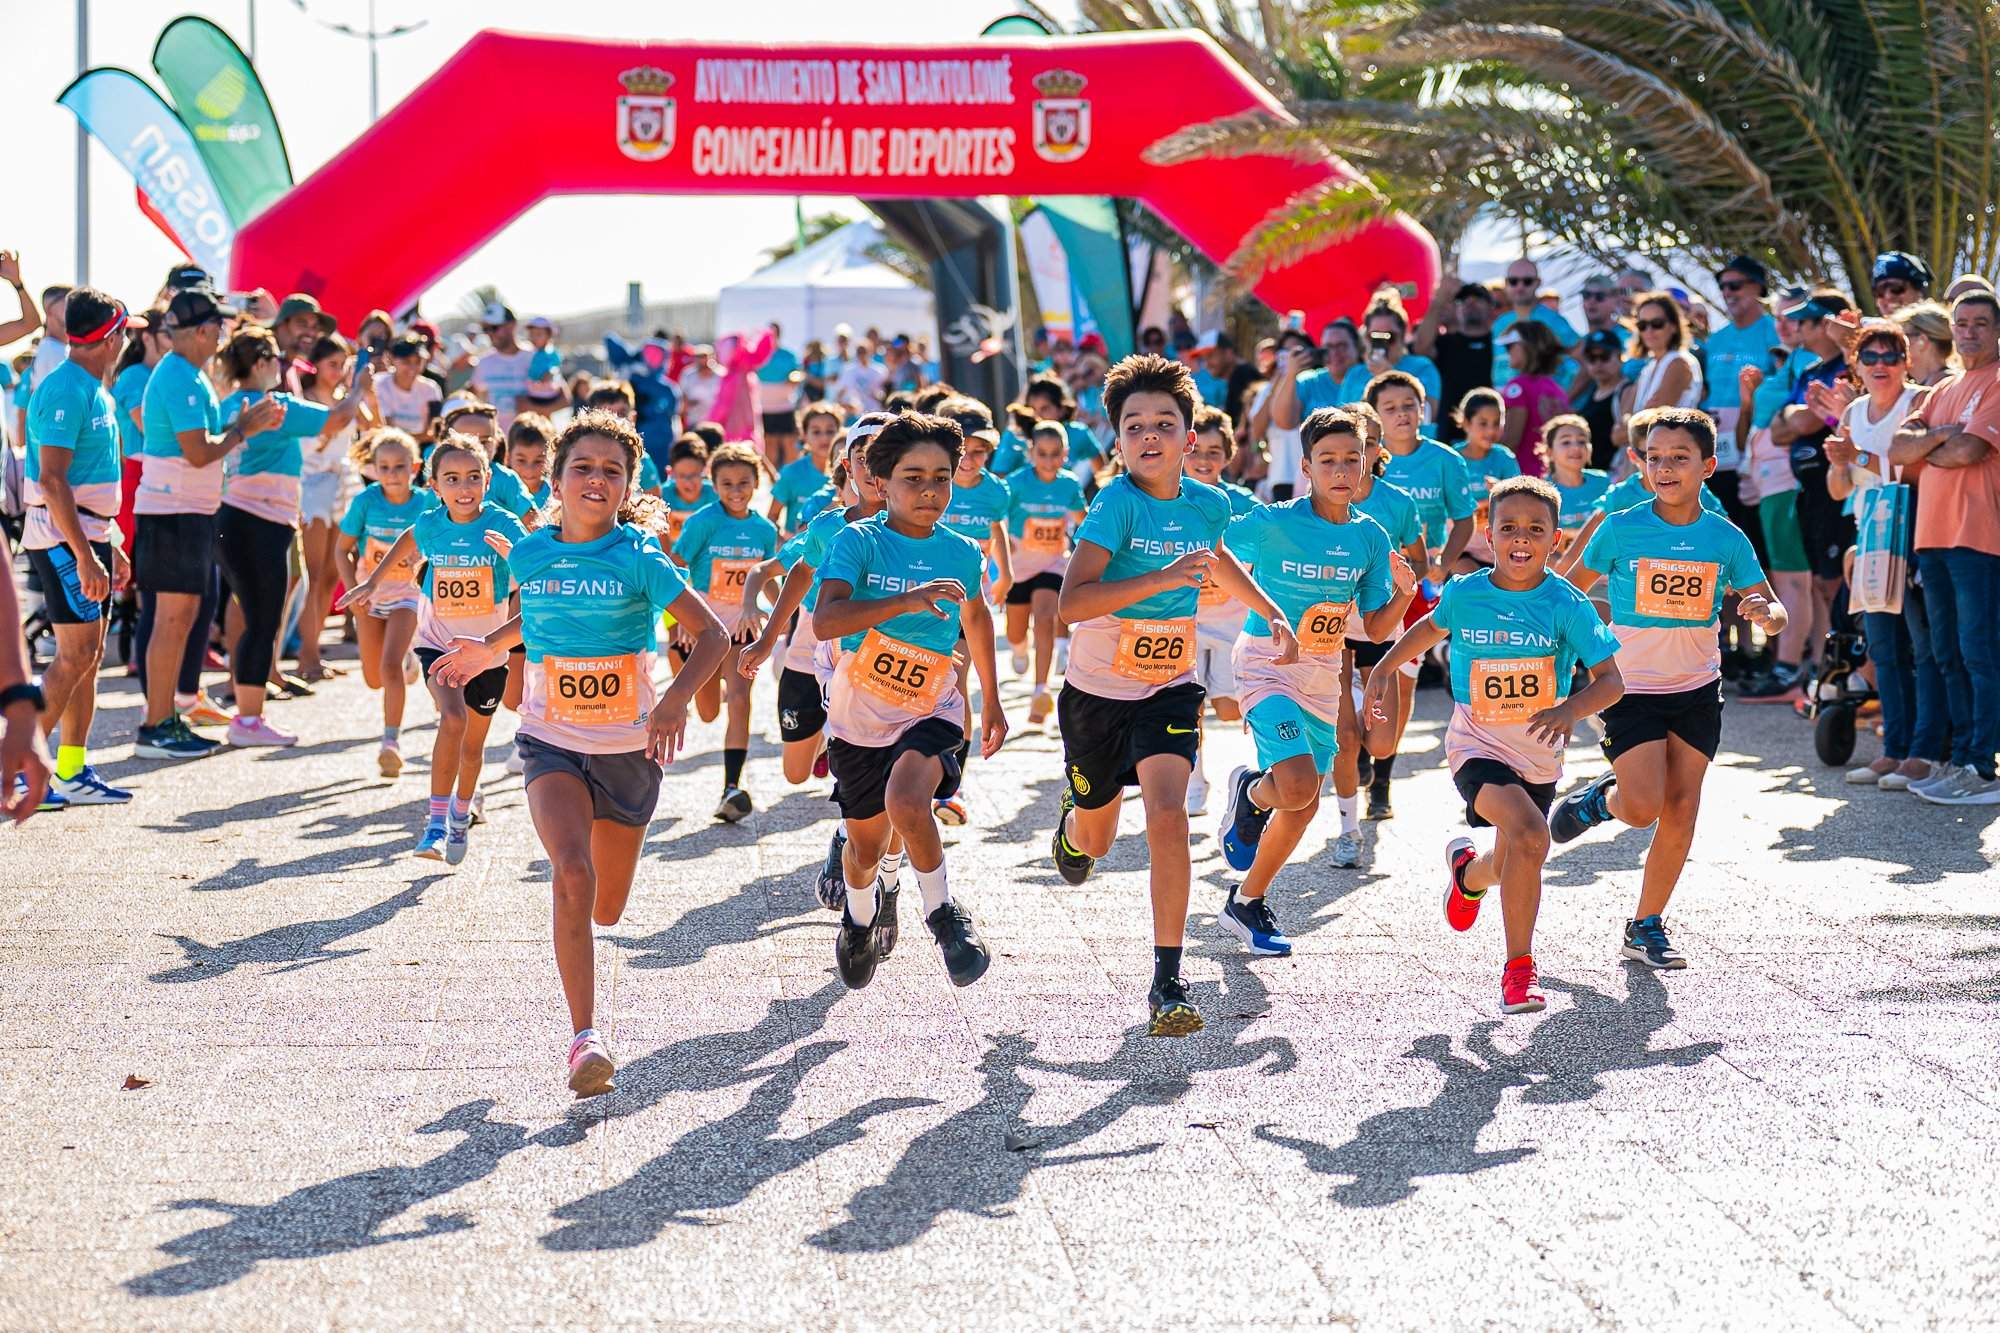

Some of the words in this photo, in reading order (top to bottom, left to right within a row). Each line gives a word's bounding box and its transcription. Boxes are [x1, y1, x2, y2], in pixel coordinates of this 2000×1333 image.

[695, 59, 835, 104] AYUNTAMIENTO
[837, 60, 863, 105] DE
[863, 60, 902, 105] SAN
[903, 54, 1015, 105] BARTOLOMÉ
[693, 117, 847, 177] CONCEJALÍA
[851, 128, 885, 176] DE
[888, 128, 1016, 177] DEPORTES
[437, 580, 480, 599] 603
[725, 570, 747, 587] 70
[1651, 573, 1702, 597] 628
[1134, 636, 1184, 659] 626
[874, 652, 929, 688] 615
[1136, 661, 1153, 671] Hugo
[559, 673, 620, 699] 600
[867, 672, 891, 688] SUPER
[1485, 674, 1539, 699] 618
[574, 702, 606, 710] manuela
